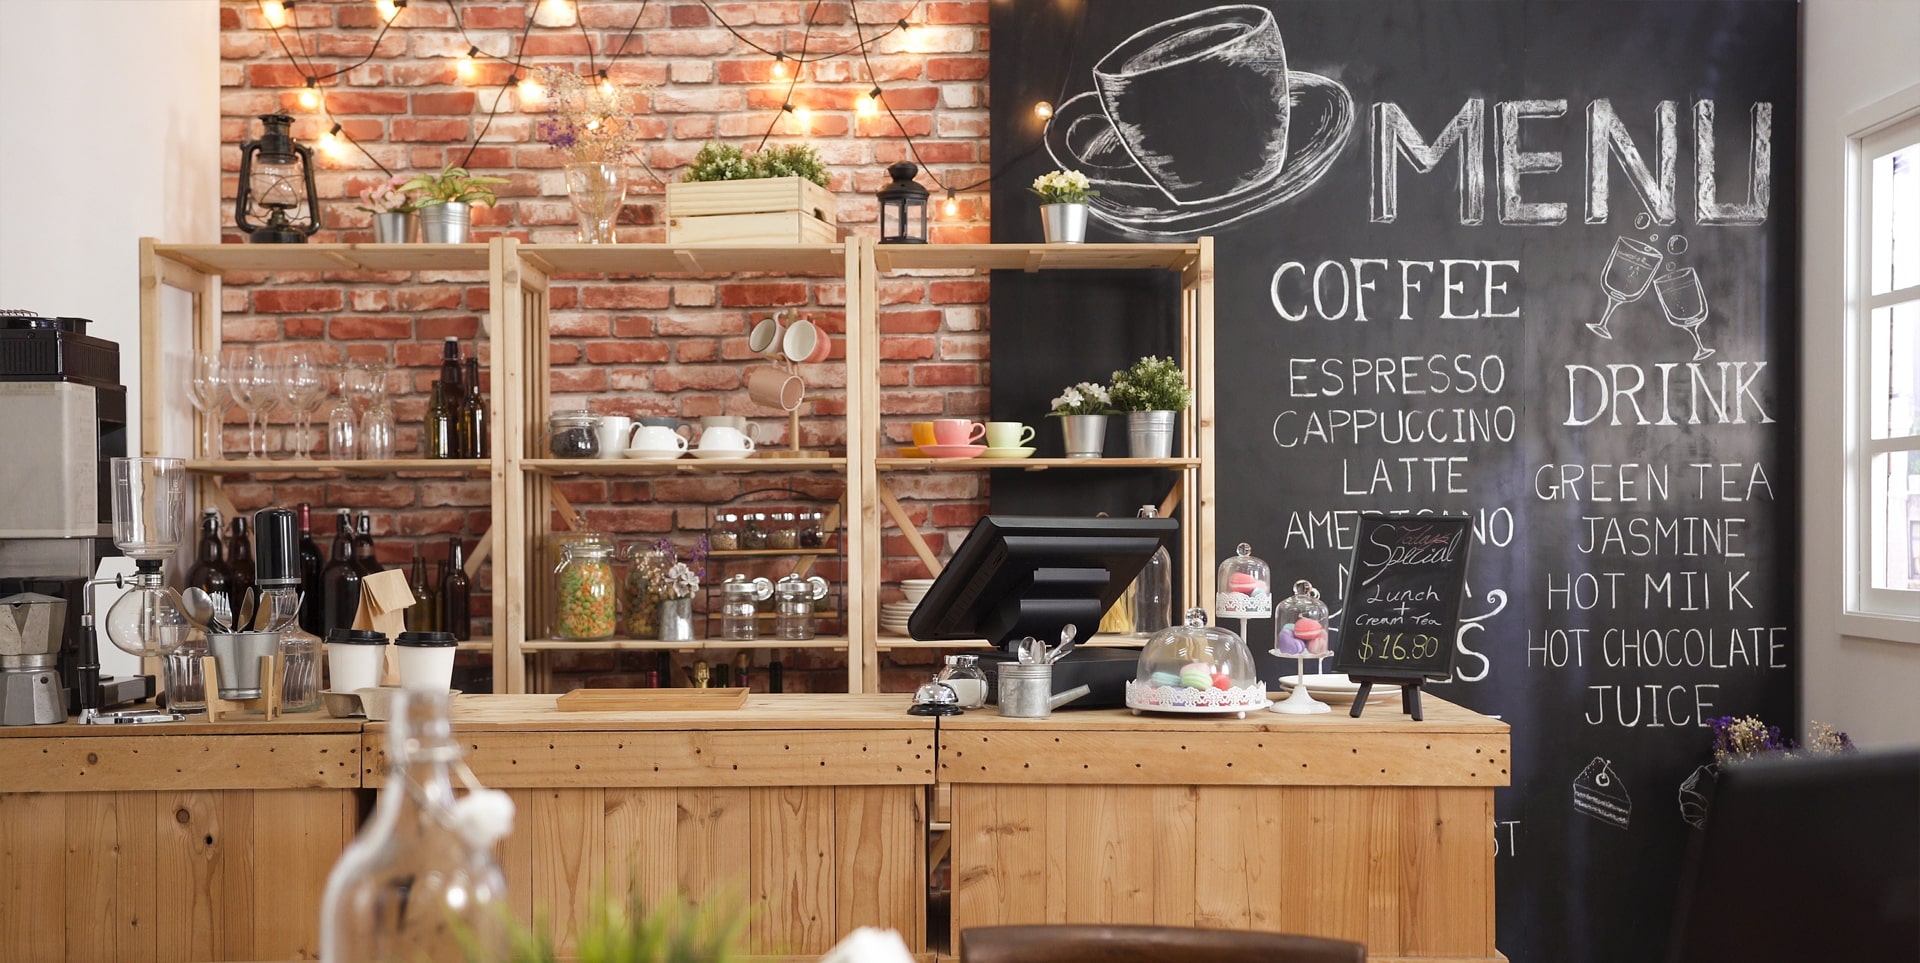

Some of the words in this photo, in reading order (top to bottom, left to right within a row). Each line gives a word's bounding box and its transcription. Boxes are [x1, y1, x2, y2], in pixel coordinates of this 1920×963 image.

[1370, 97, 1773, 226] MENU
[1270, 257, 1520, 322] COFFEE
[1289, 354, 1506, 398] ESPRESSO
[1562, 360, 1776, 427] DRINK
[1272, 405, 1517, 448] CAPPUCCINO
[1343, 456, 1469, 495] LATTE
[1535, 463, 1669, 502] GREEN
[1689, 461, 1775, 502] TEA
[1284, 506, 1515, 550] AMENO
[1577, 516, 1746, 558] JASMINE
[1362, 523, 1464, 586] Special
[1366, 584, 1441, 604] Lunch
[1547, 572, 1625, 611] HOT
[1355, 613, 1404, 627] Cream
[1410, 611, 1443, 627] Tea
[1357, 630, 1440, 663] $16.80
[1526, 628, 1590, 668] HOT
[1602, 627, 1788, 669] CHOCOLATE
[1584, 684, 1720, 728] JUICE
